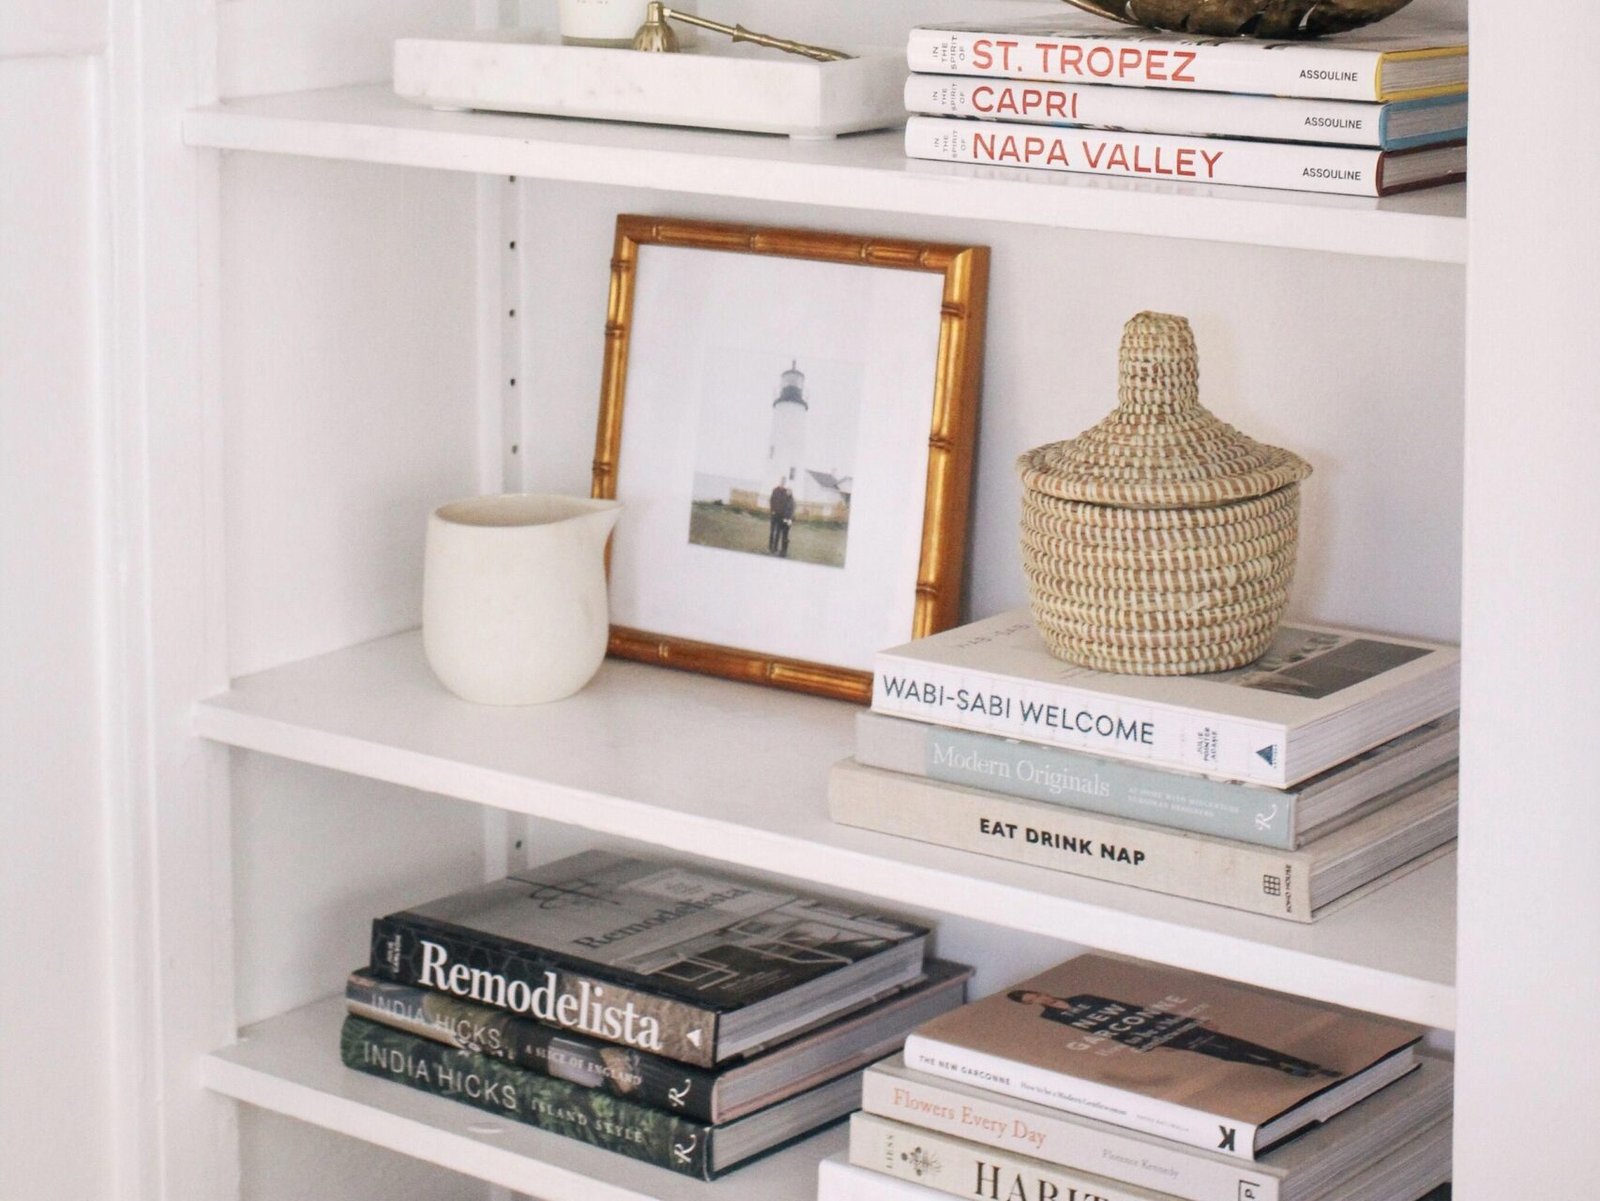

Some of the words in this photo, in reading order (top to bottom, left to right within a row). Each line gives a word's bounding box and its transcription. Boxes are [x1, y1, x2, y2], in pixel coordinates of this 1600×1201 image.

[932, 46, 938, 57] IN
[950, 35, 958, 70] SPIRIT
[959, 46, 965, 61] OF
[972, 39, 1022, 72] ST.
[1035, 43, 1197, 82] TROPEZ
[1299, 69, 1358, 81] ASSOULINE
[971, 86, 1078, 119] CAPRI
[1304, 116, 1362, 129] ASSOULINE
[972, 132, 1070, 167] NAPA
[1082, 140, 1224, 178] VALLEY
[1302, 167, 1362, 181] ASSOULINE
[882, 674, 1012, 718] WABI-SABI
[1019, 699, 1156, 745] WELCOME
[932, 742, 1011, 779] Modern
[1016, 759, 1111, 797] Originals
[979, 818, 1018, 839] EAT
[1025, 827, 1093, 856] DRINK
[1100, 843, 1145, 866] NAP
[573, 888, 752, 949] Remodelista
[417, 939, 663, 1051] Remodelista
[1061, 1003, 1091, 1017] THE
[1071, 1003, 1127, 1029] NEW
[372, 993, 425, 1023] INDIA
[436, 1013, 501, 1050] HICKS
[1066, 995, 1187, 1051] GARCONNE
[363, 1041, 431, 1083] INDIA
[438, 1064, 517, 1110] HICKS
[587, 1061, 643, 1086] ENGLAND
[919, 1055, 935, 1066] THE
[938, 1060, 958, 1071] NEW
[961, 1066, 1011, 1086] GARCONNE
[531, 1100, 588, 1126] ISLAND
[595, 1119, 644, 1144] STYLE
[894, 1087, 955, 1119] Flowers
[961, 1105, 1008, 1138] Every
[1013, 1119, 1047, 1149] Day
